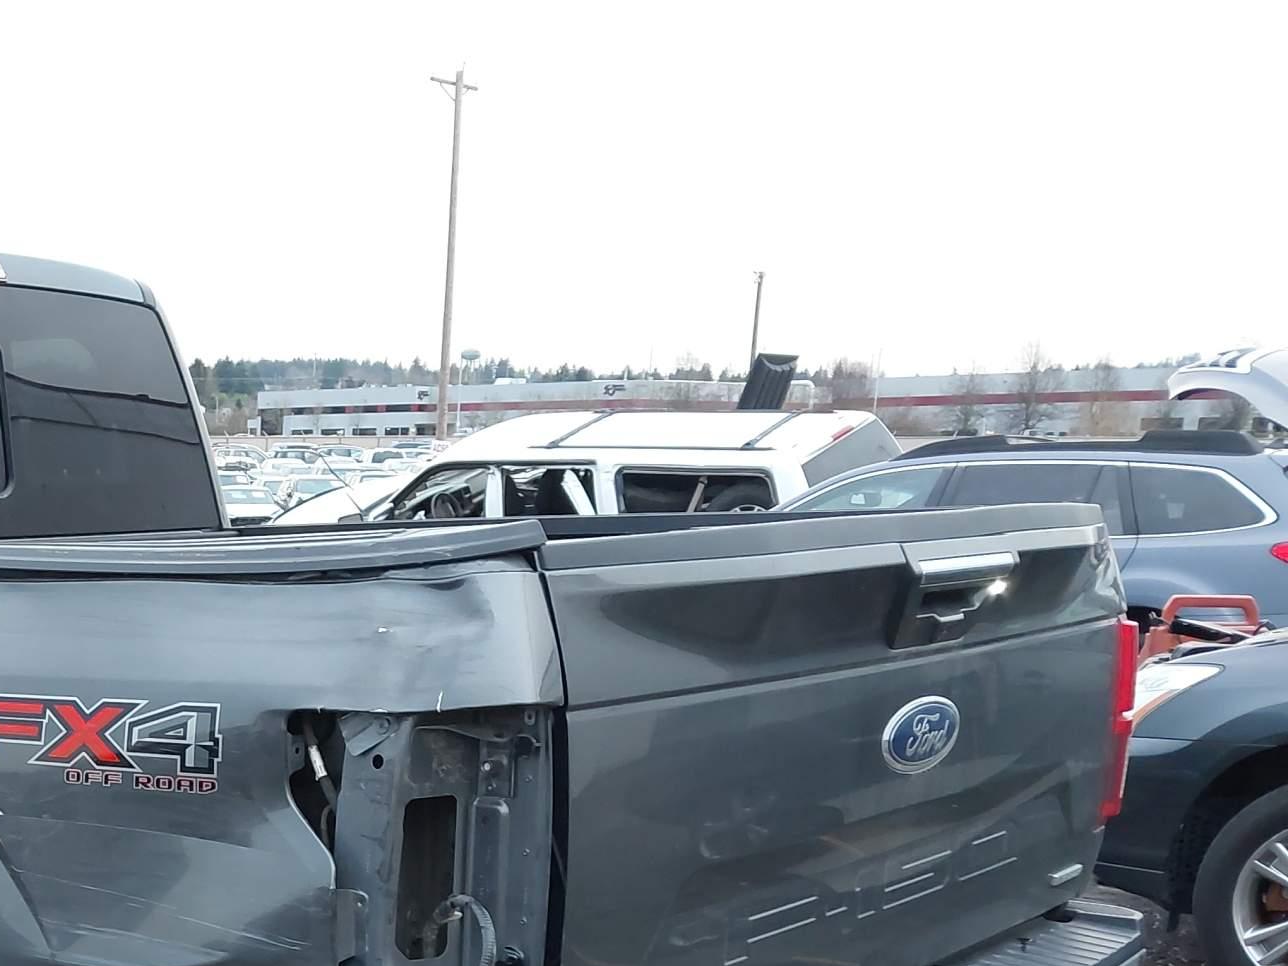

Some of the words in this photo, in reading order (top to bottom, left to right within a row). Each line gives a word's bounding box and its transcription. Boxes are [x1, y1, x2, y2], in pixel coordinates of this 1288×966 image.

[906, 712, 950, 757] Ford
[65, 769, 123, 786] OFF
[133, 774, 218, 795] ROAD
